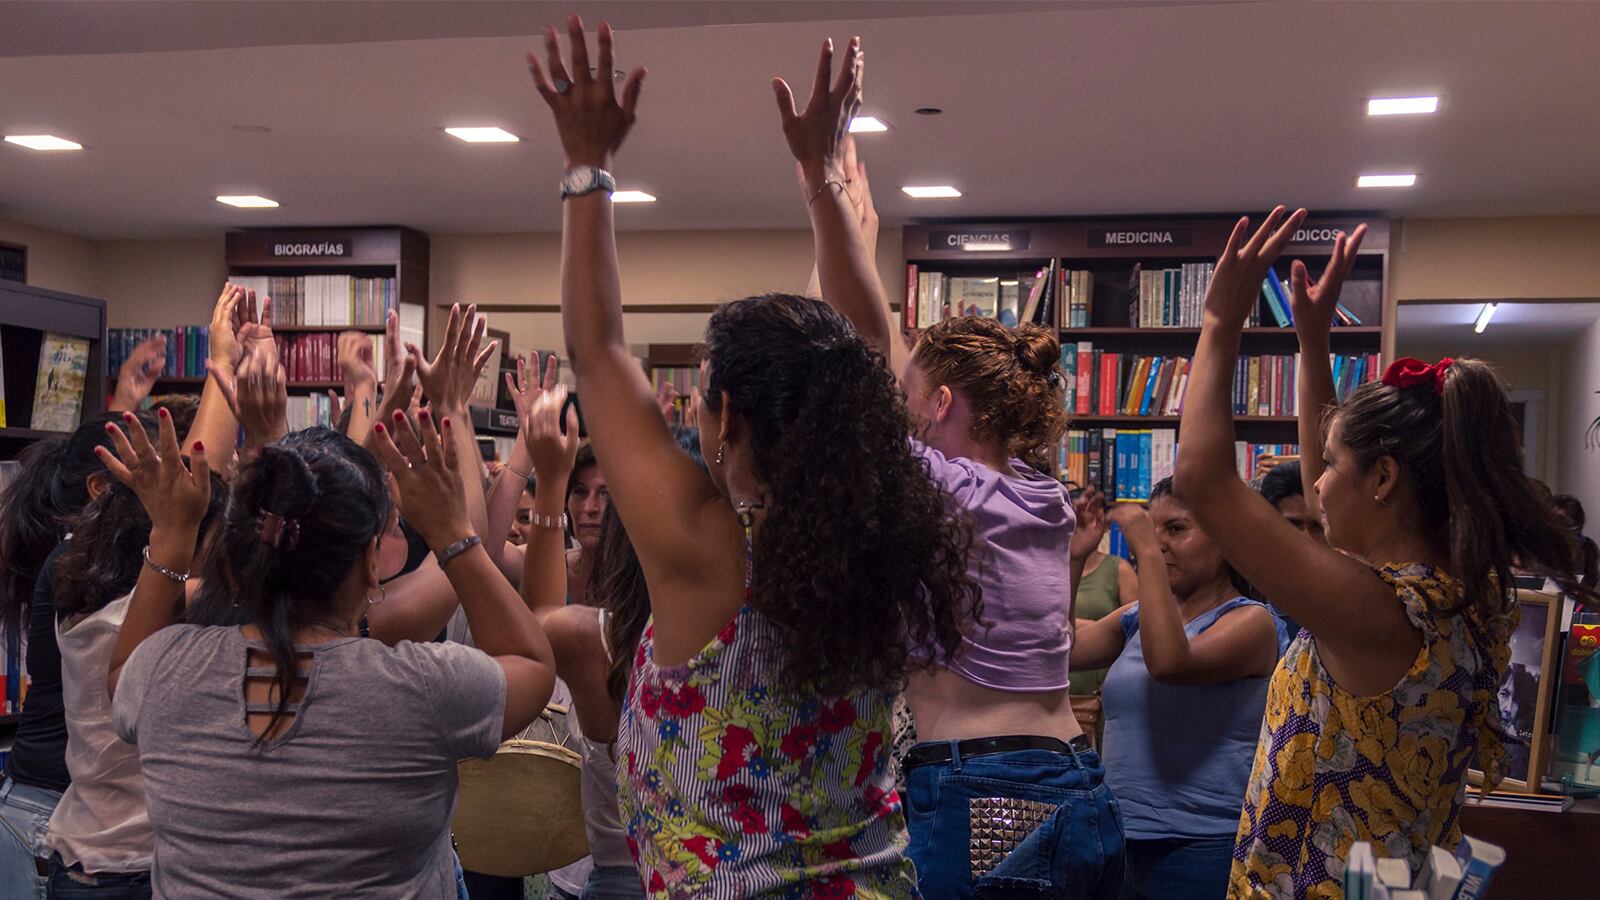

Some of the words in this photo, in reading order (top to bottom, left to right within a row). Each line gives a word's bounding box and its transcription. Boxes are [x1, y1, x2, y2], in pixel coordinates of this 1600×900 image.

[946, 234, 1010, 246] CIENCIAS
[1105, 231, 1173, 244] MEDICINA
[274, 241, 344, 256] BIOGRAFÍAS
